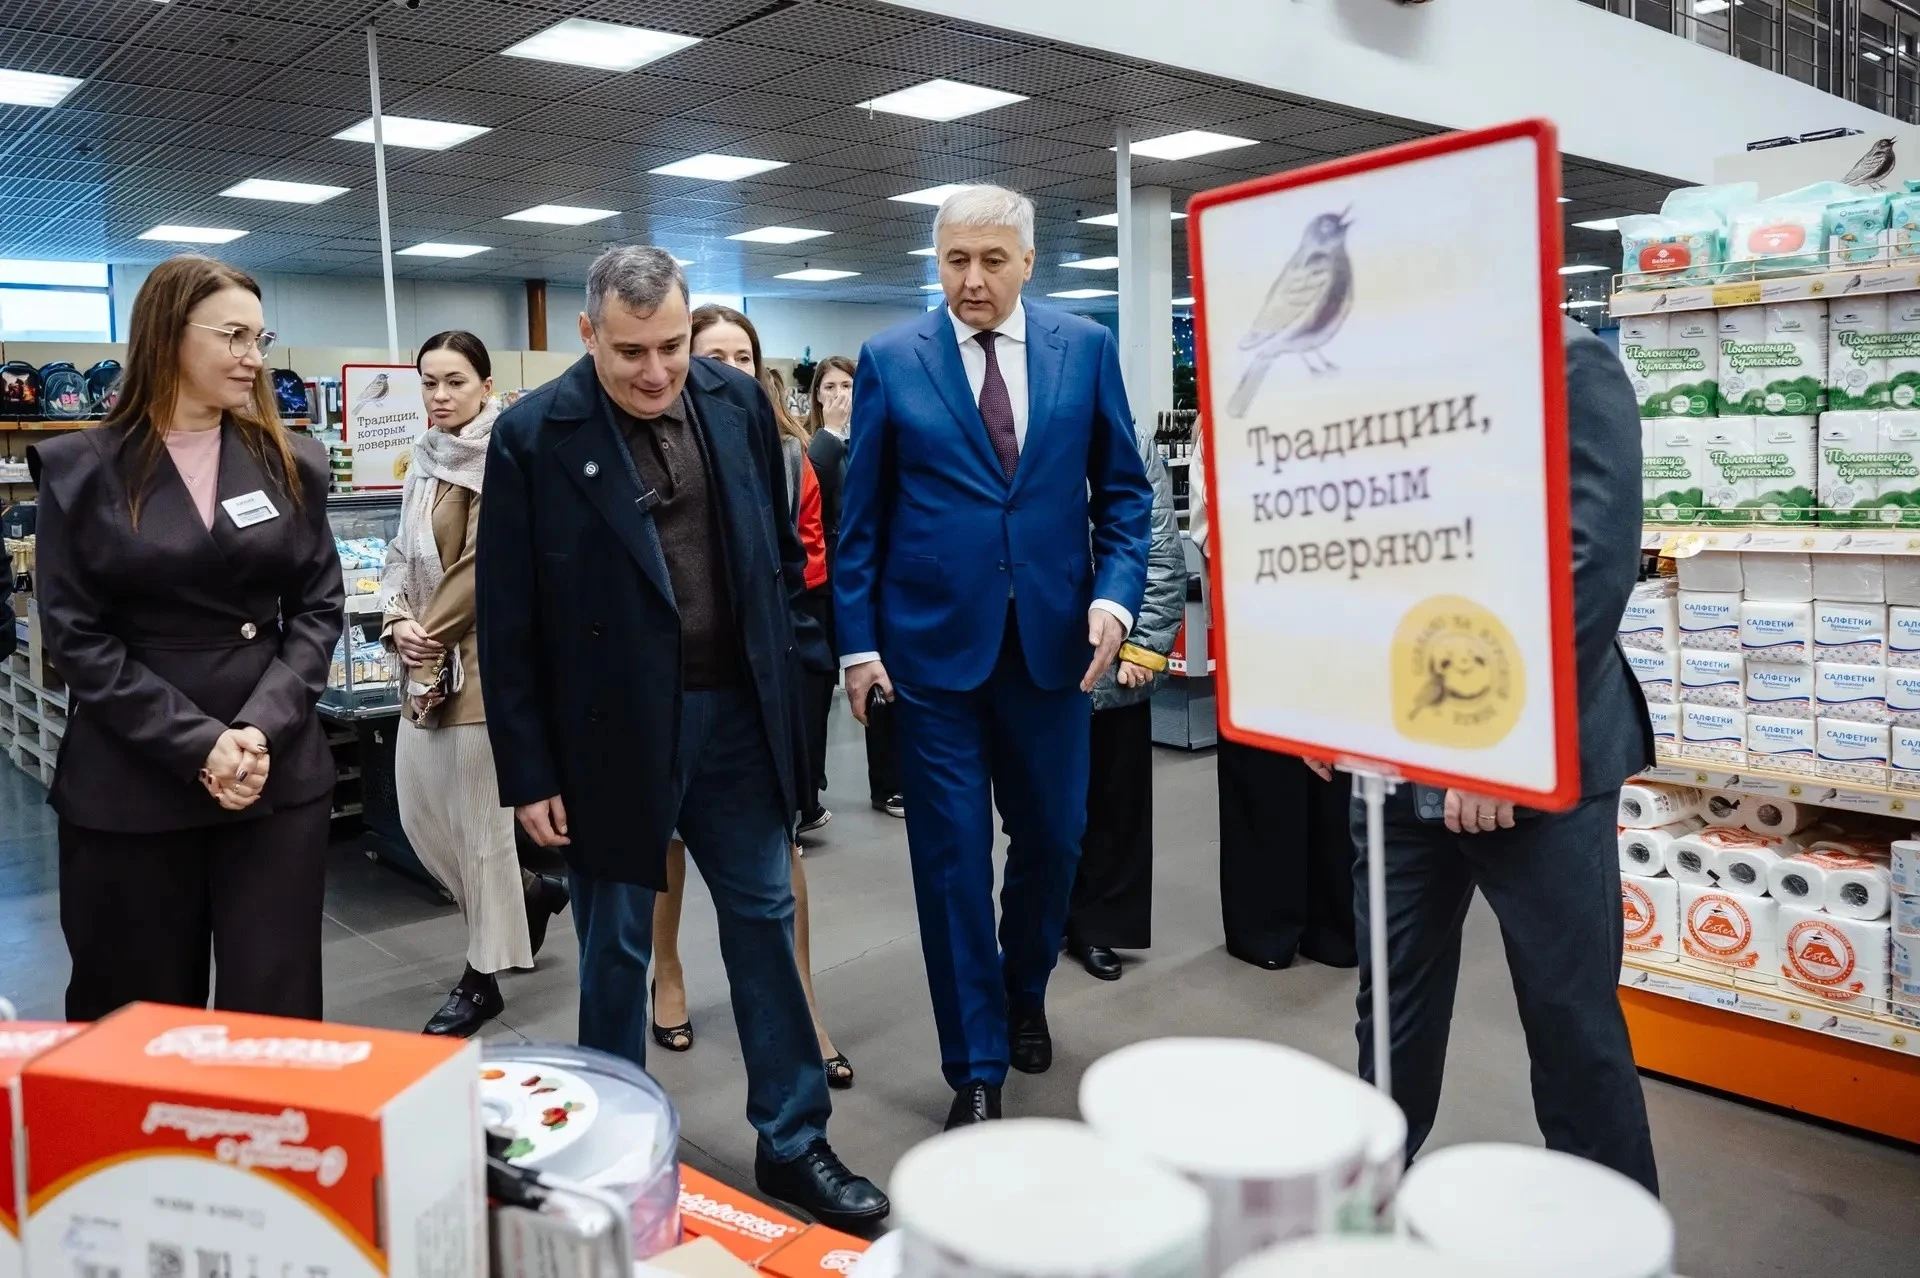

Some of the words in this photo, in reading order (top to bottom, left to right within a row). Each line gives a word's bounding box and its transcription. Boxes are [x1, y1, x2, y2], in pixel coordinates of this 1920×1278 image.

[1627, 345, 1699, 361] Полотенца
[1721, 340, 1794, 357] Полотенца
[1852, 346, 1920, 365] бумажны
[1637, 360, 1704, 377] бумажные
[1730, 355, 1801, 373] бумажные
[357, 412, 419, 428] Традиции,
[357, 425, 406, 439] которым
[1246, 393, 1492, 474] Традиции,
[357, 435, 415, 452] доверяют!
[1642, 456, 1684, 468] тенца
[1711, 451, 1787, 467] Полотенца
[1825, 449, 1912, 466] Полотенца
[1723, 466, 1795, 483] бумажные
[1839, 464, 1918, 482] бумажные
[1251, 466, 1431, 523] которым
[1254, 516, 1475, 584] доверяют!
[1626, 606, 1655, 615] ЛФЕТКИ
[1684, 603, 1729, 613] САЛФЕТКИ
[1746, 619, 1794, 628] САЛФЕТКИ
[1821, 616, 1872, 627] САЛФЕТКИ
[1628, 657, 1664, 666] АЛФЕТКИ
[1686, 659, 1730, 669] САЛФЕТКИ
[1753, 672, 1801, 683] САЛФЕТКИ
[1824, 673, 1875, 683] САЛФЕТКИ
[1688, 712, 1733, 724] САЛФЕТКИ
[1755, 725, 1803, 735] САЛФЕТКИ
[1826, 730, 1878, 743] САЛФЕТКИ
[1702, 920, 1737, 936] Ester
[1802, 947, 1838, 965] Ester
